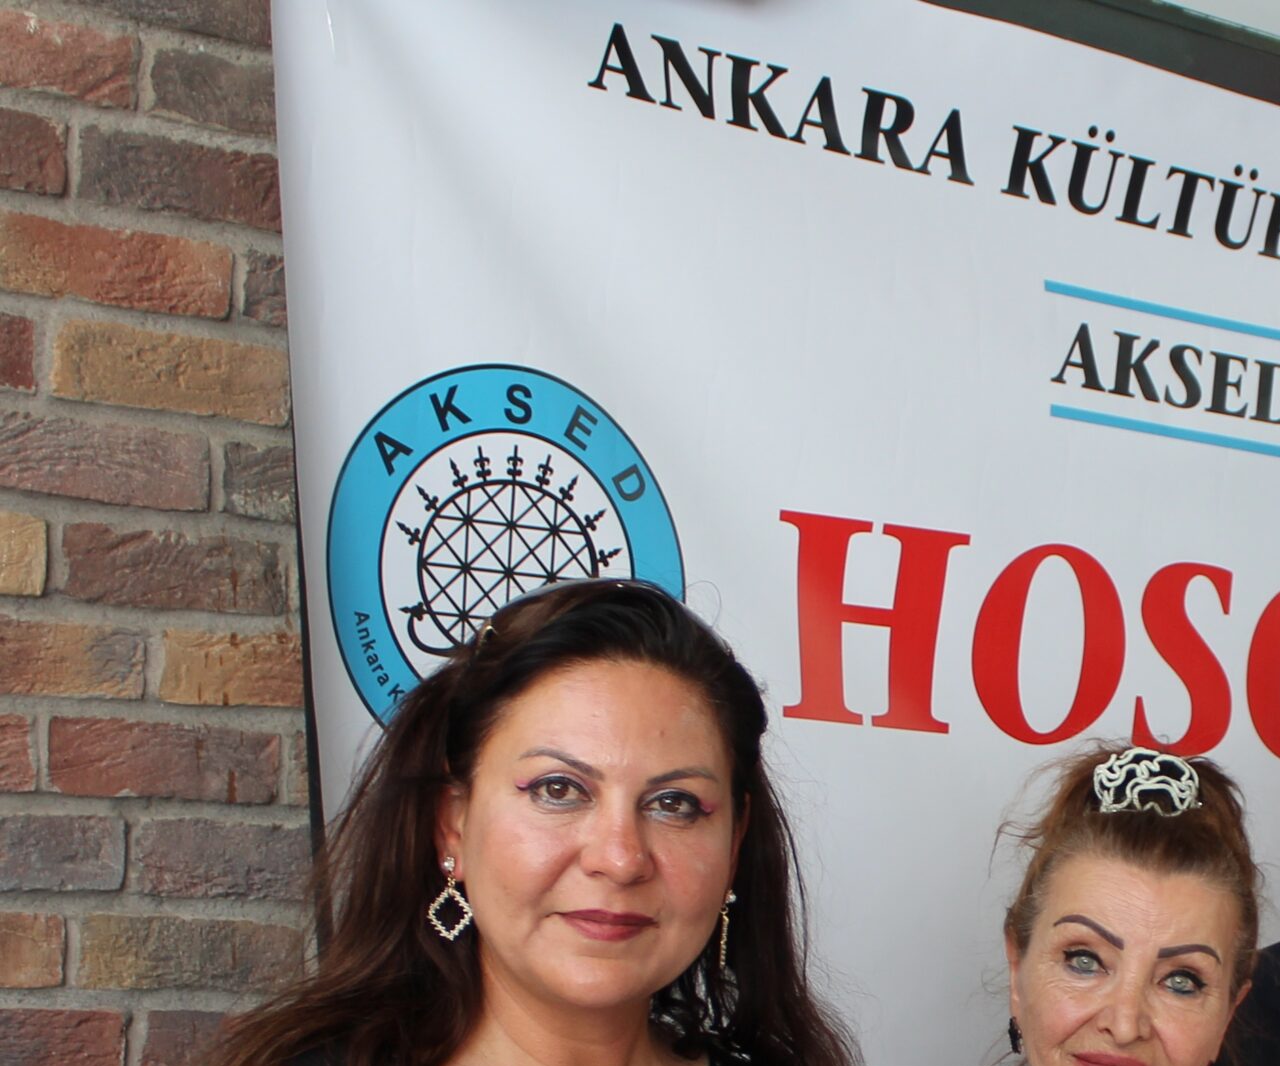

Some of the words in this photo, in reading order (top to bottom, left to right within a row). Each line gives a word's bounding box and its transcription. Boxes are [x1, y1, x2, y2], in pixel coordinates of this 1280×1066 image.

[588, 22, 974, 186] ANKARA
[373, 383, 647, 502] AKSED
[354, 611, 390, 687] Ankara
